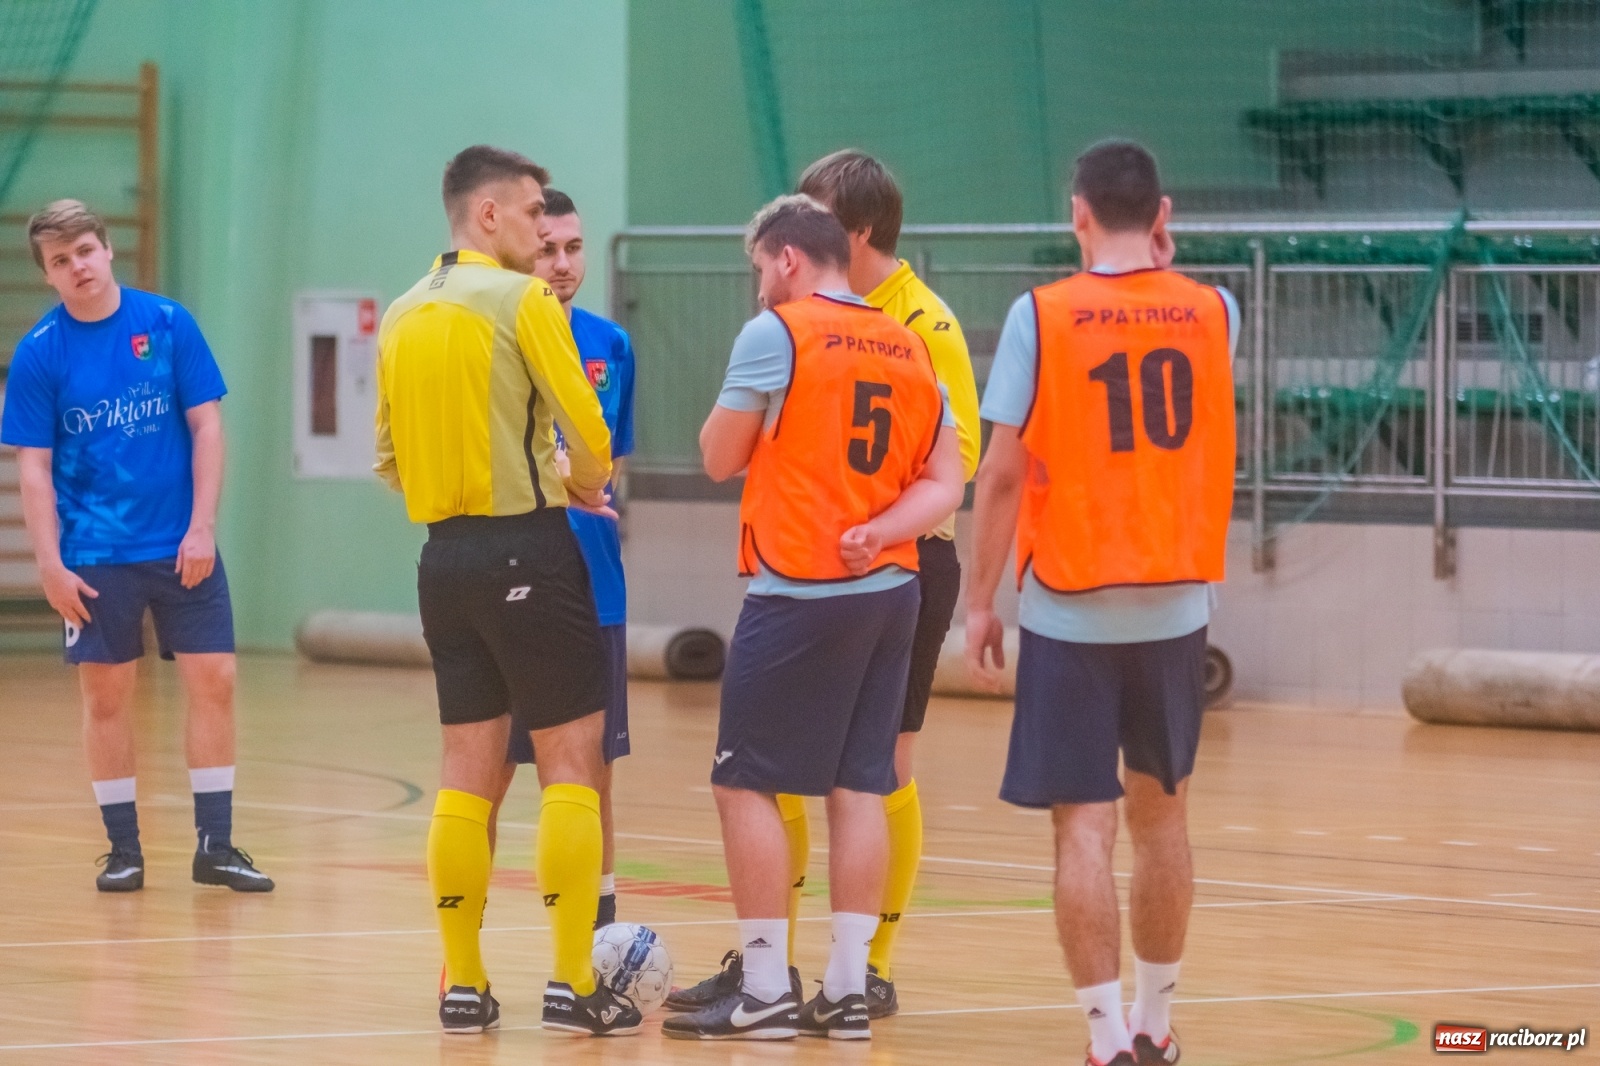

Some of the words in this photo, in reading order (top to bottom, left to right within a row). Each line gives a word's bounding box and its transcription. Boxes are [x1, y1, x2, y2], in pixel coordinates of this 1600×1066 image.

[1101, 307, 1198, 324] PATRICK
[846, 335, 914, 360] PATRICK
[847, 380, 893, 476] 5
[1088, 347, 1194, 453] 10
